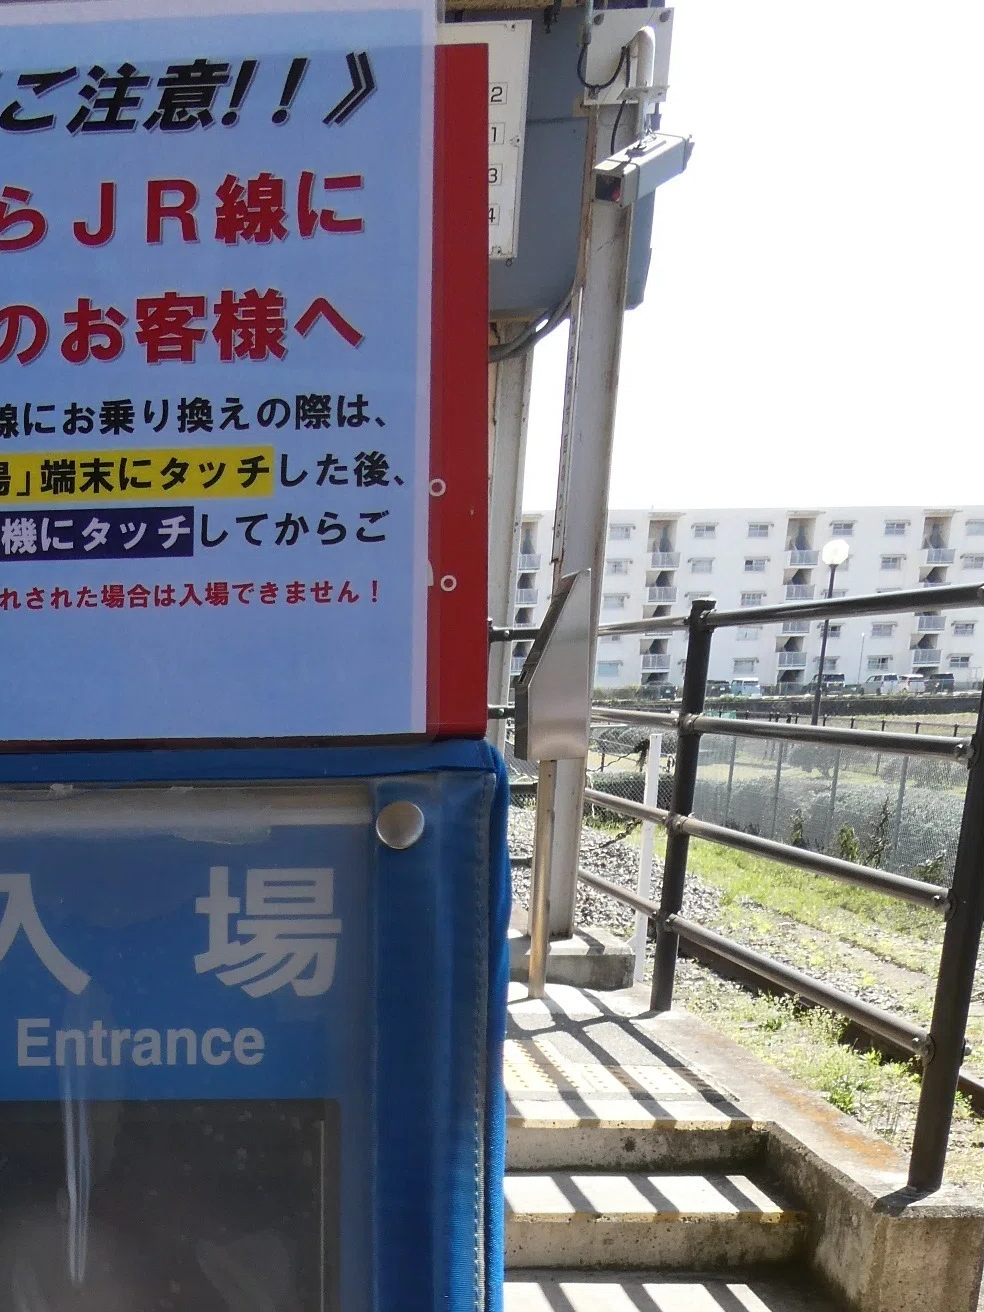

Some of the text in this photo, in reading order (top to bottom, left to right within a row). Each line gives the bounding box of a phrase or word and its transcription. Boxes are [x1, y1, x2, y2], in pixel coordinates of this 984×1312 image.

[491, 86, 503, 102] 2
[491, 127, 497, 142] 1
[488, 168, 498, 183] 3
[16, 1018, 265, 1067] Entrance
